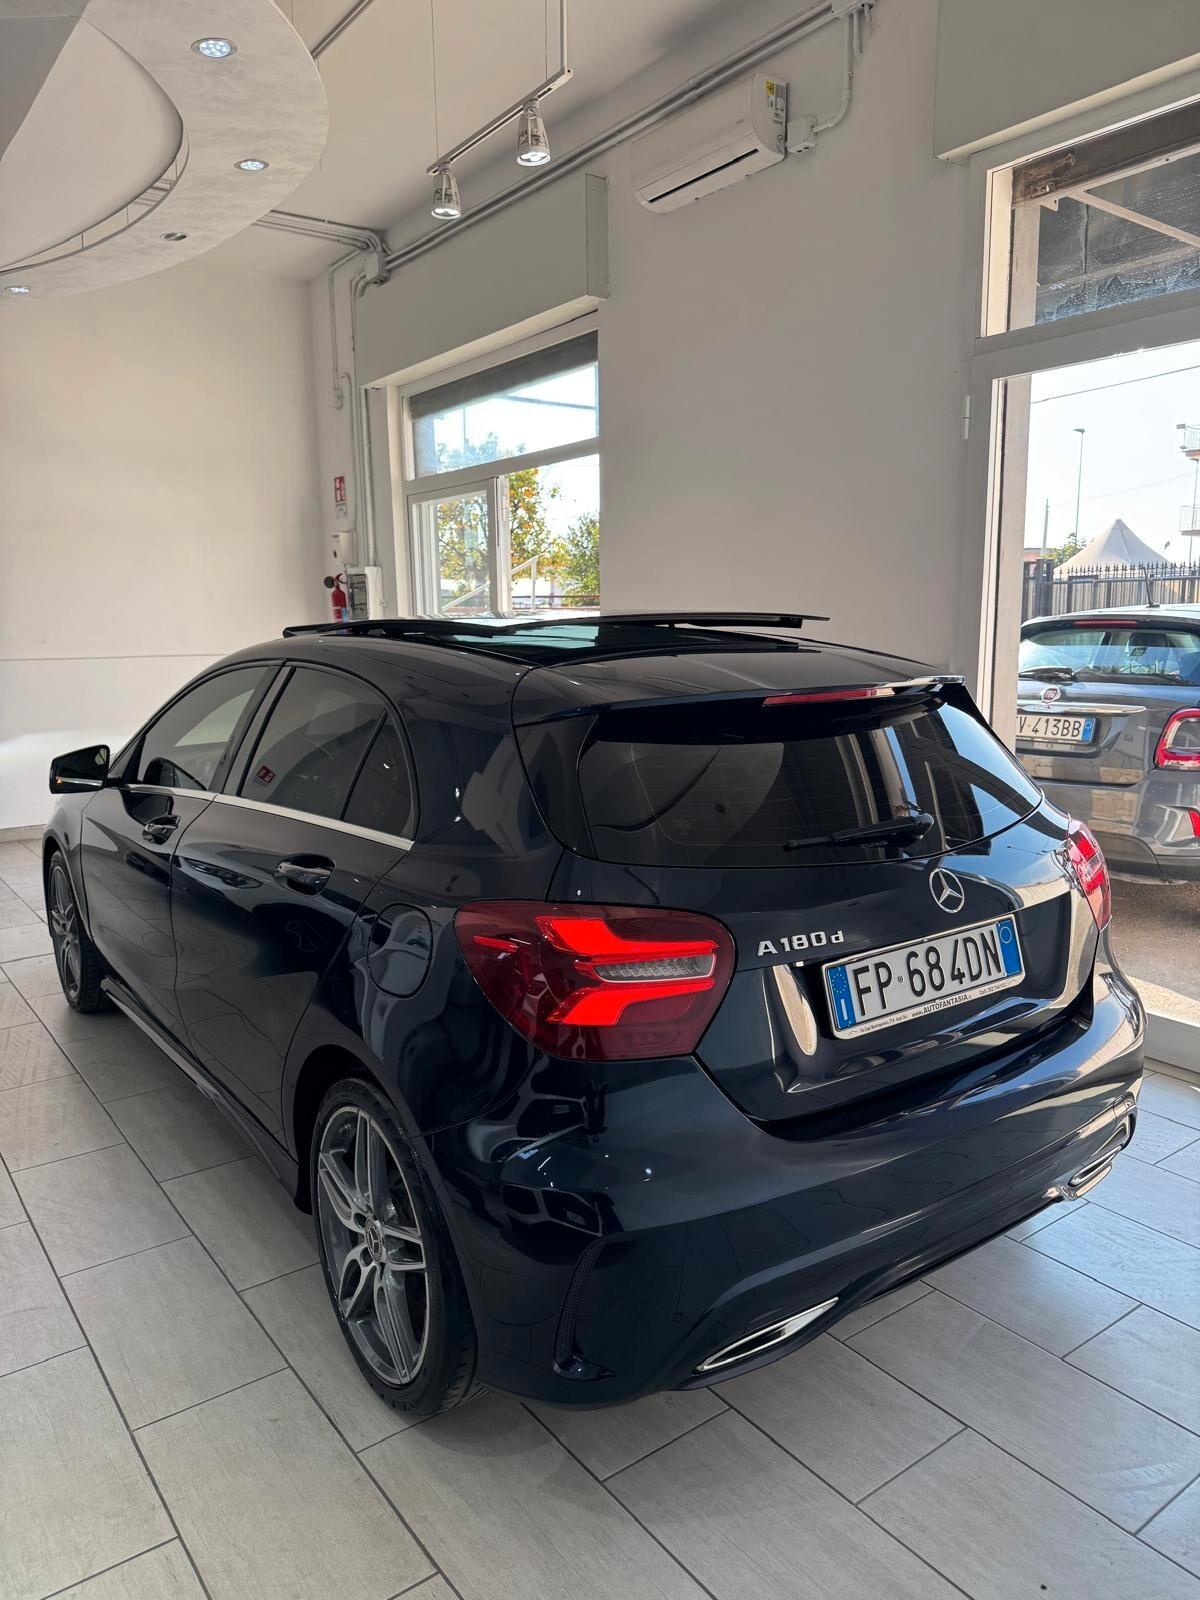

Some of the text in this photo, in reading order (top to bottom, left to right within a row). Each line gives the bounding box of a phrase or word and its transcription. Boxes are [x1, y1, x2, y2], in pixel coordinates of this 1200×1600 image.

[1031, 717, 1082, 738] 413BB
[853, 929, 1002, 1017] FP 684DN
